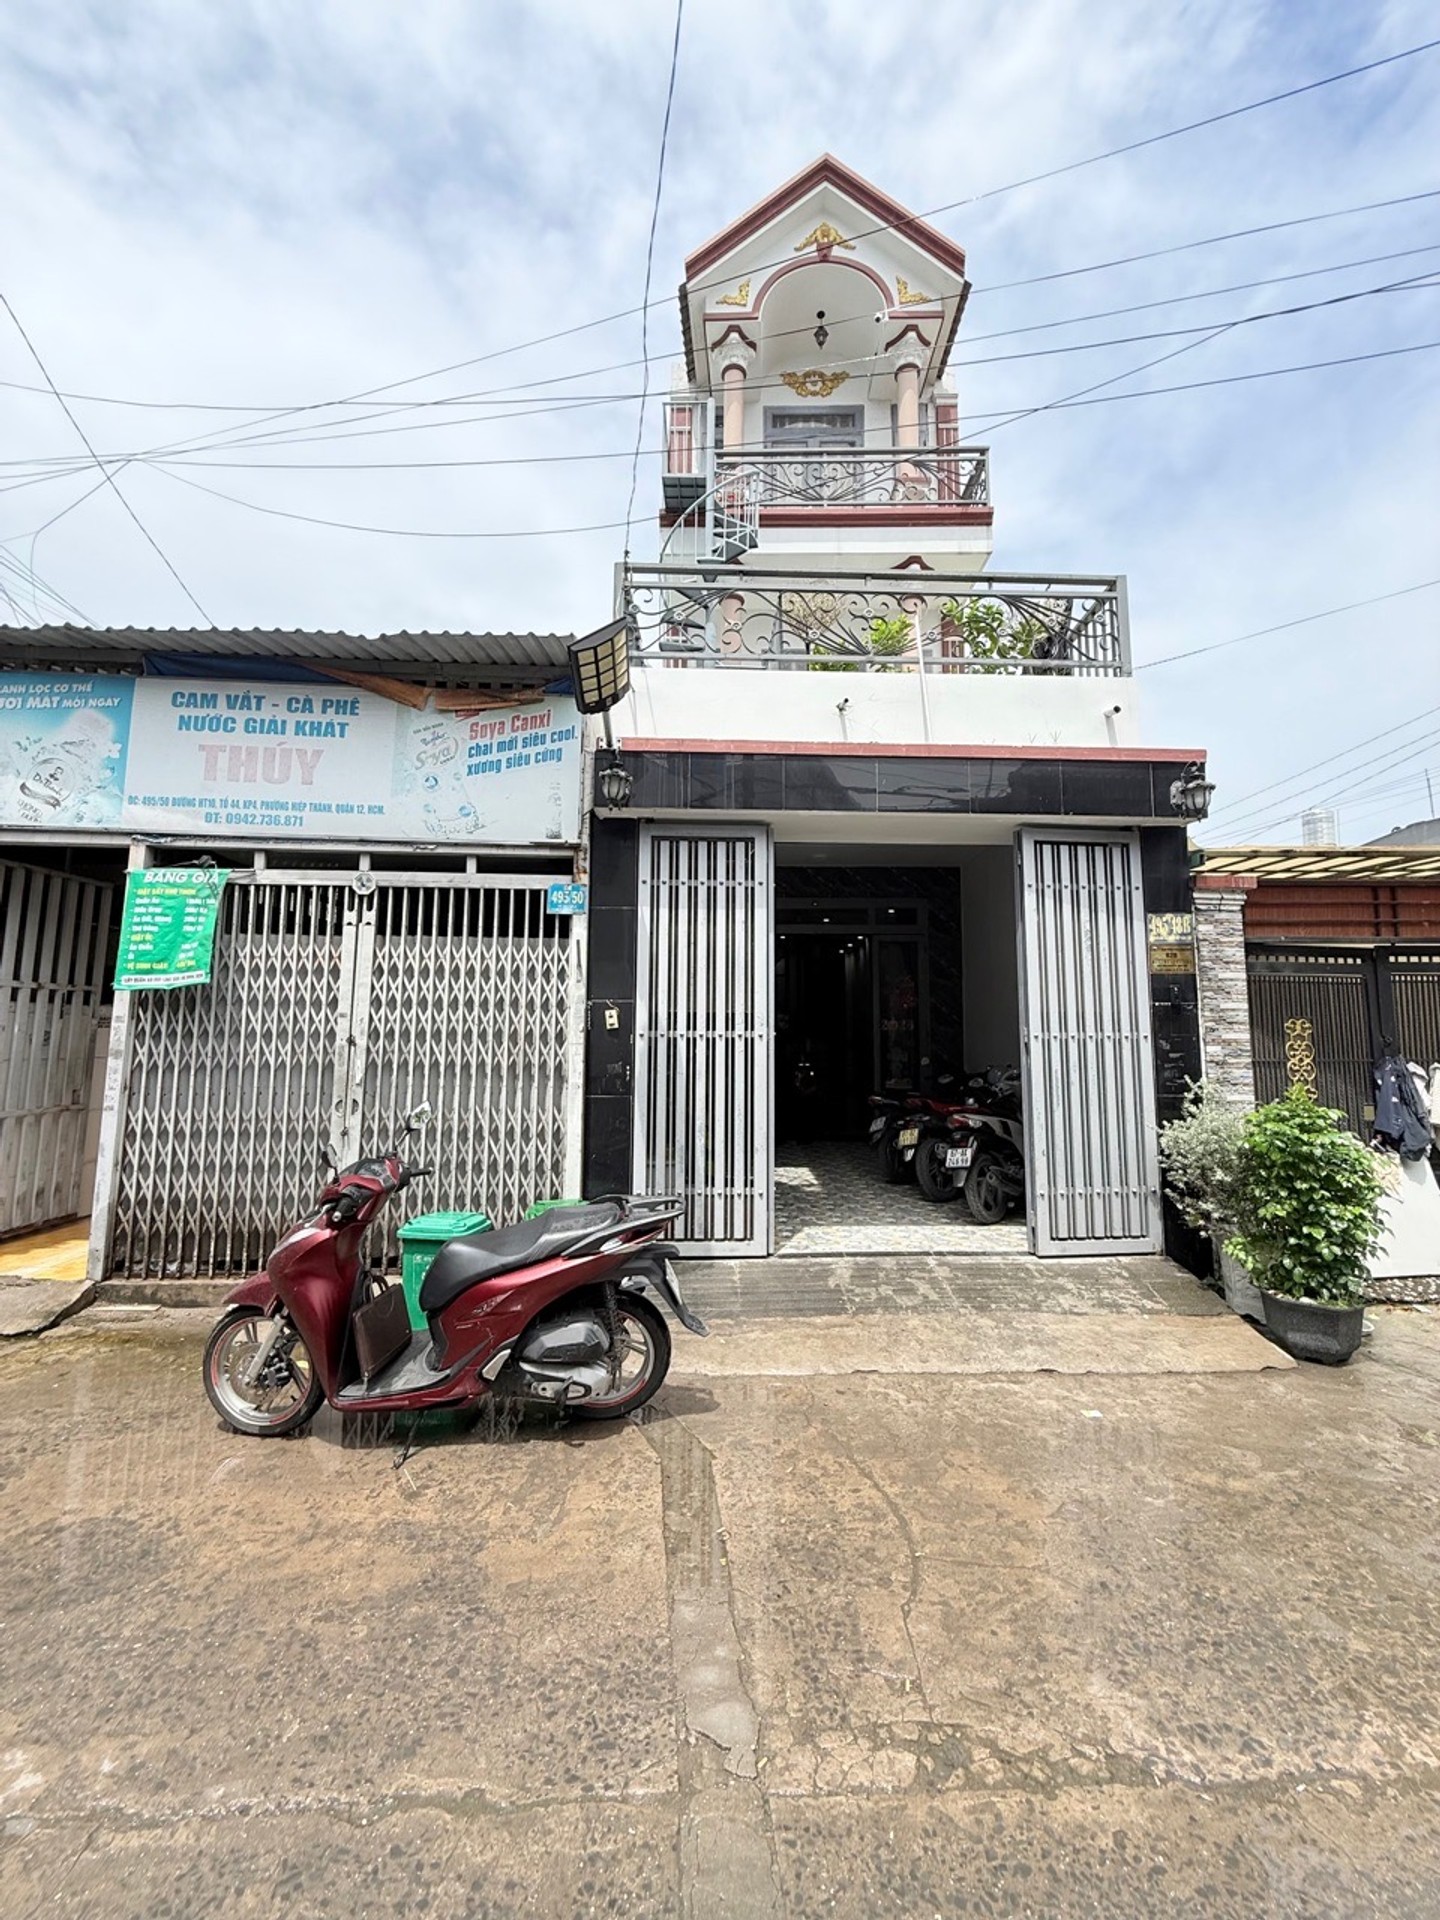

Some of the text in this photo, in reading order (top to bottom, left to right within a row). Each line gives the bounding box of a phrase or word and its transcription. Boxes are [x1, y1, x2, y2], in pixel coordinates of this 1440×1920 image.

[0, 684, 26, 694] ANH
[171, 691, 219, 709] CAM
[286, 694, 315, 714] CÀ
[321, 695, 360, 716] PHÊ
[177, 713, 349, 738] NƯỚC GIẢI KHÁT
[469, 720, 506, 742] Soya
[511, 709, 552, 733] Canxi
[468, 742, 493, 759] chai
[496, 736, 519, 753] mới
[521, 732, 547, 749] siêu
[198, 741, 325, 786] THÚY
[466, 759, 502, 777] xương
[505, 753, 531, 769] siêu
[534, 747, 563, 764] cứng
[142, 796, 169, 807] 495/50
[225, 813, 304, 827] 0942.736.871
